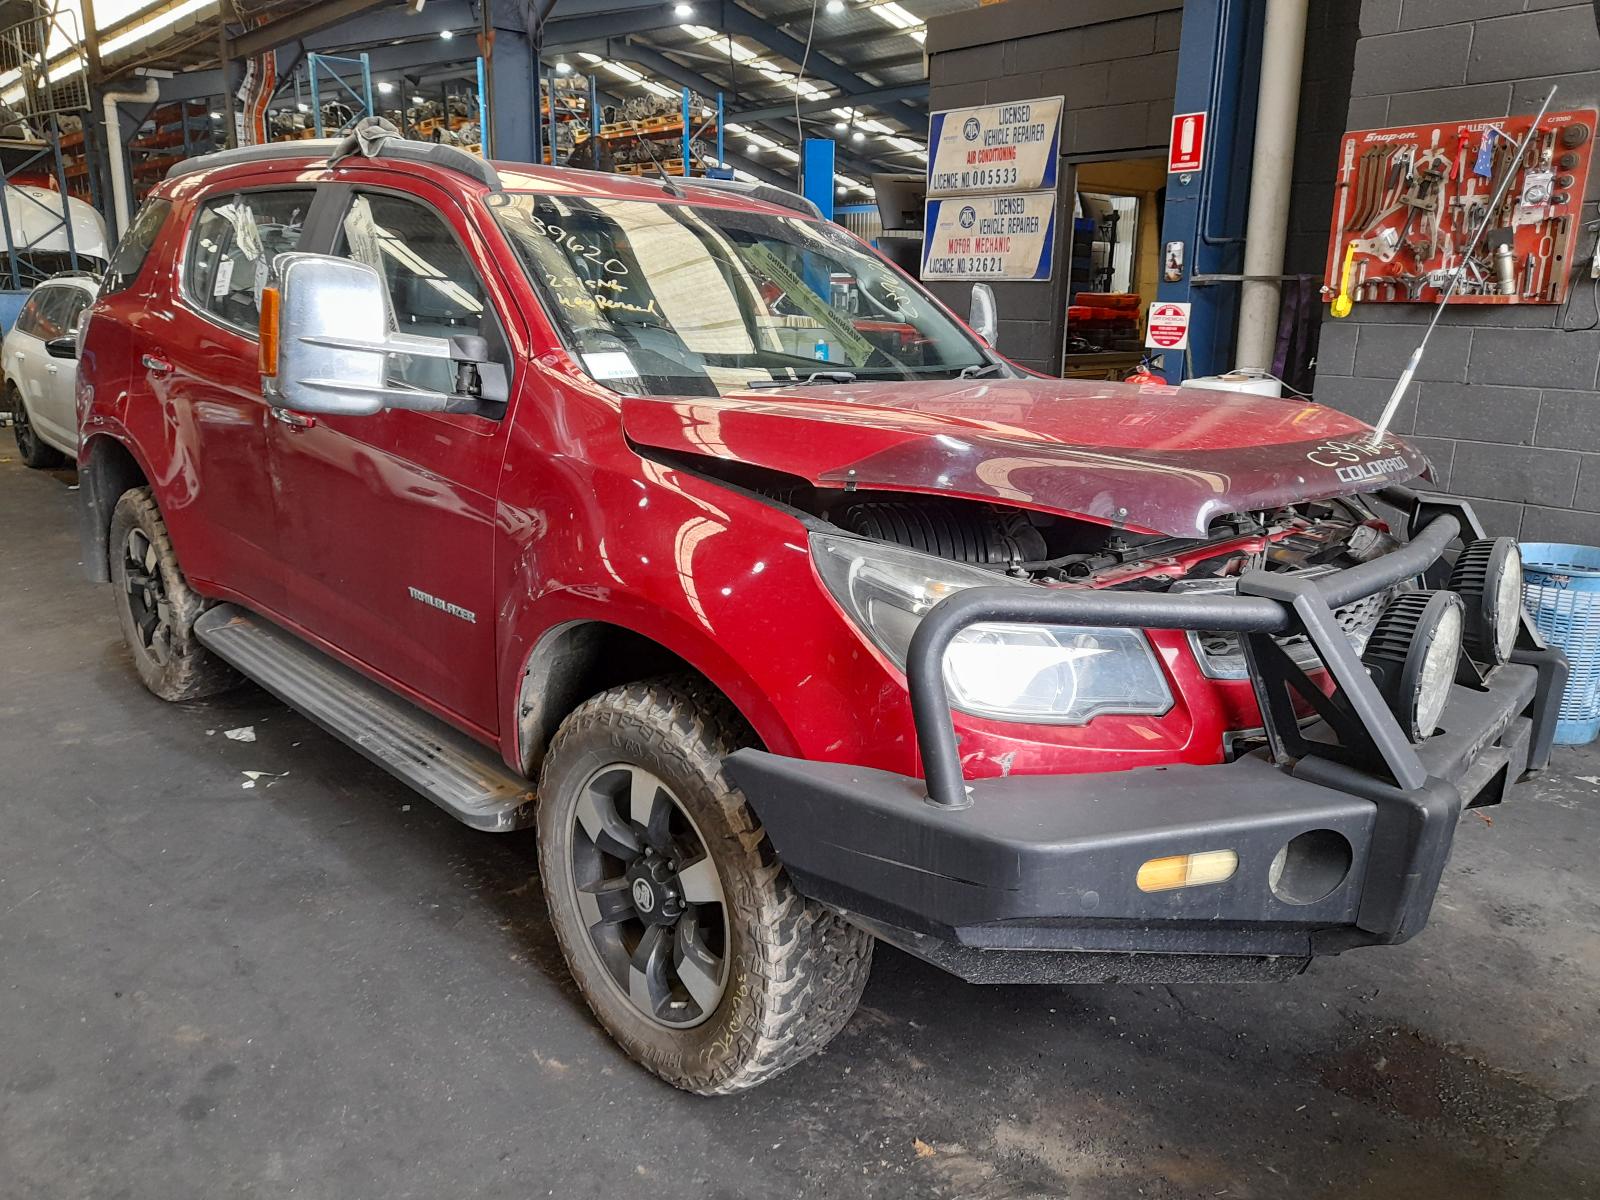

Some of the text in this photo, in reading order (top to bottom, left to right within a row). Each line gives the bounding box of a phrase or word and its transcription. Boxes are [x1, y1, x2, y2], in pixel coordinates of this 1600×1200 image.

[999, 105, 1031, 125] LICENSED
[984, 123, 1045, 146] VEHICLE REPAIRER
[1363, 131, 1418, 143] Snap-on
[966, 146, 1017, 164] AIR CONDITIONING
[934, 172, 958, 190] LICENCE
[972, 168, 1017, 186] 005533
[993, 198, 1025, 215] LICENSED
[979, 216, 1040, 235] VEHICLE REPAIRER
[948, 236, 1011, 255] MOTOR MECHANIC
[929, 257, 954, 274] LICENCE
[968, 257, 1003, 272] 32621
[1334, 455, 1409, 483] COLORADO
[407, 586, 477, 624] TRAILBLAZER
